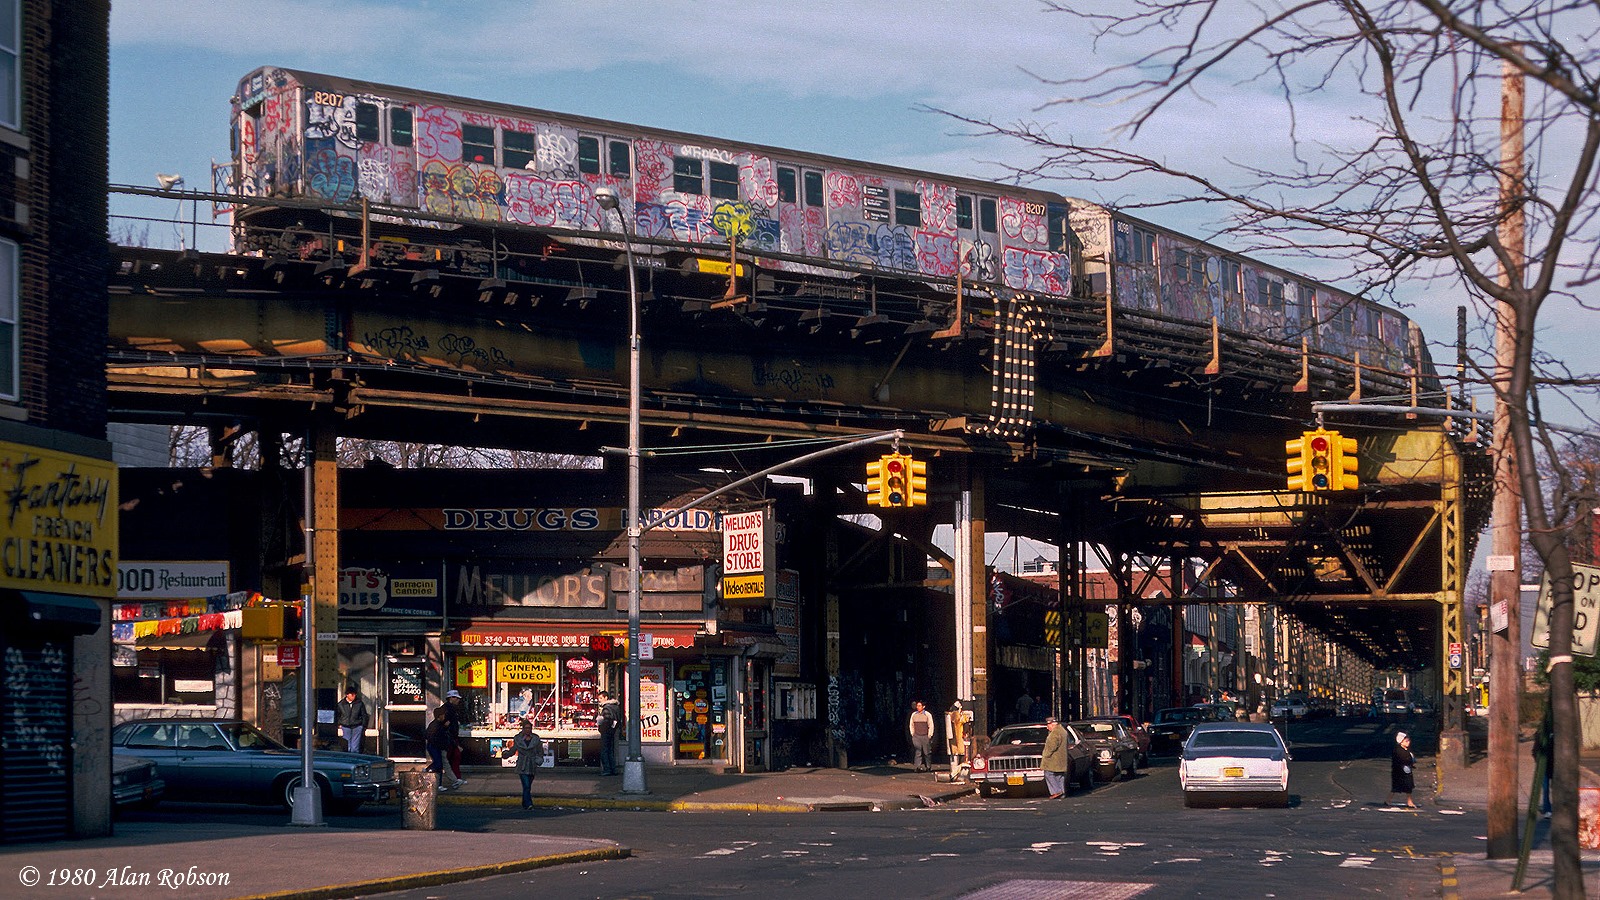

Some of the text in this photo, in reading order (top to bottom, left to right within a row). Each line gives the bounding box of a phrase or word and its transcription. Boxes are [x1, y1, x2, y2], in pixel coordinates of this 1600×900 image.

[314, 91, 344, 108] 8207
[1025, 202, 1046, 216] 8207
[4, 453, 110, 529] Fantasy
[32, 515, 92, 542] FRENCH
[443, 508, 600, 531] DRUGS
[725, 512, 762, 532] MELLOR'S
[729, 532, 759, 552] DRUG
[3, 537, 112, 586] CLEANERS
[725, 551, 762, 571] STORE
[158, 569, 226, 591] Restaurant
[725, 581, 744, 595] Video
[744, 582, 763, 594] RENTALS
[1581, 597, 1596, 608] ON
[462, 635, 481, 643] LOTTO
[532, 635, 558, 645] MELLORS
[561, 636, 577, 644] DRUG
[505, 664, 548, 672] CINEMA
[509, 672, 544, 680] VIDEO
[642, 729, 661, 738] HERE
